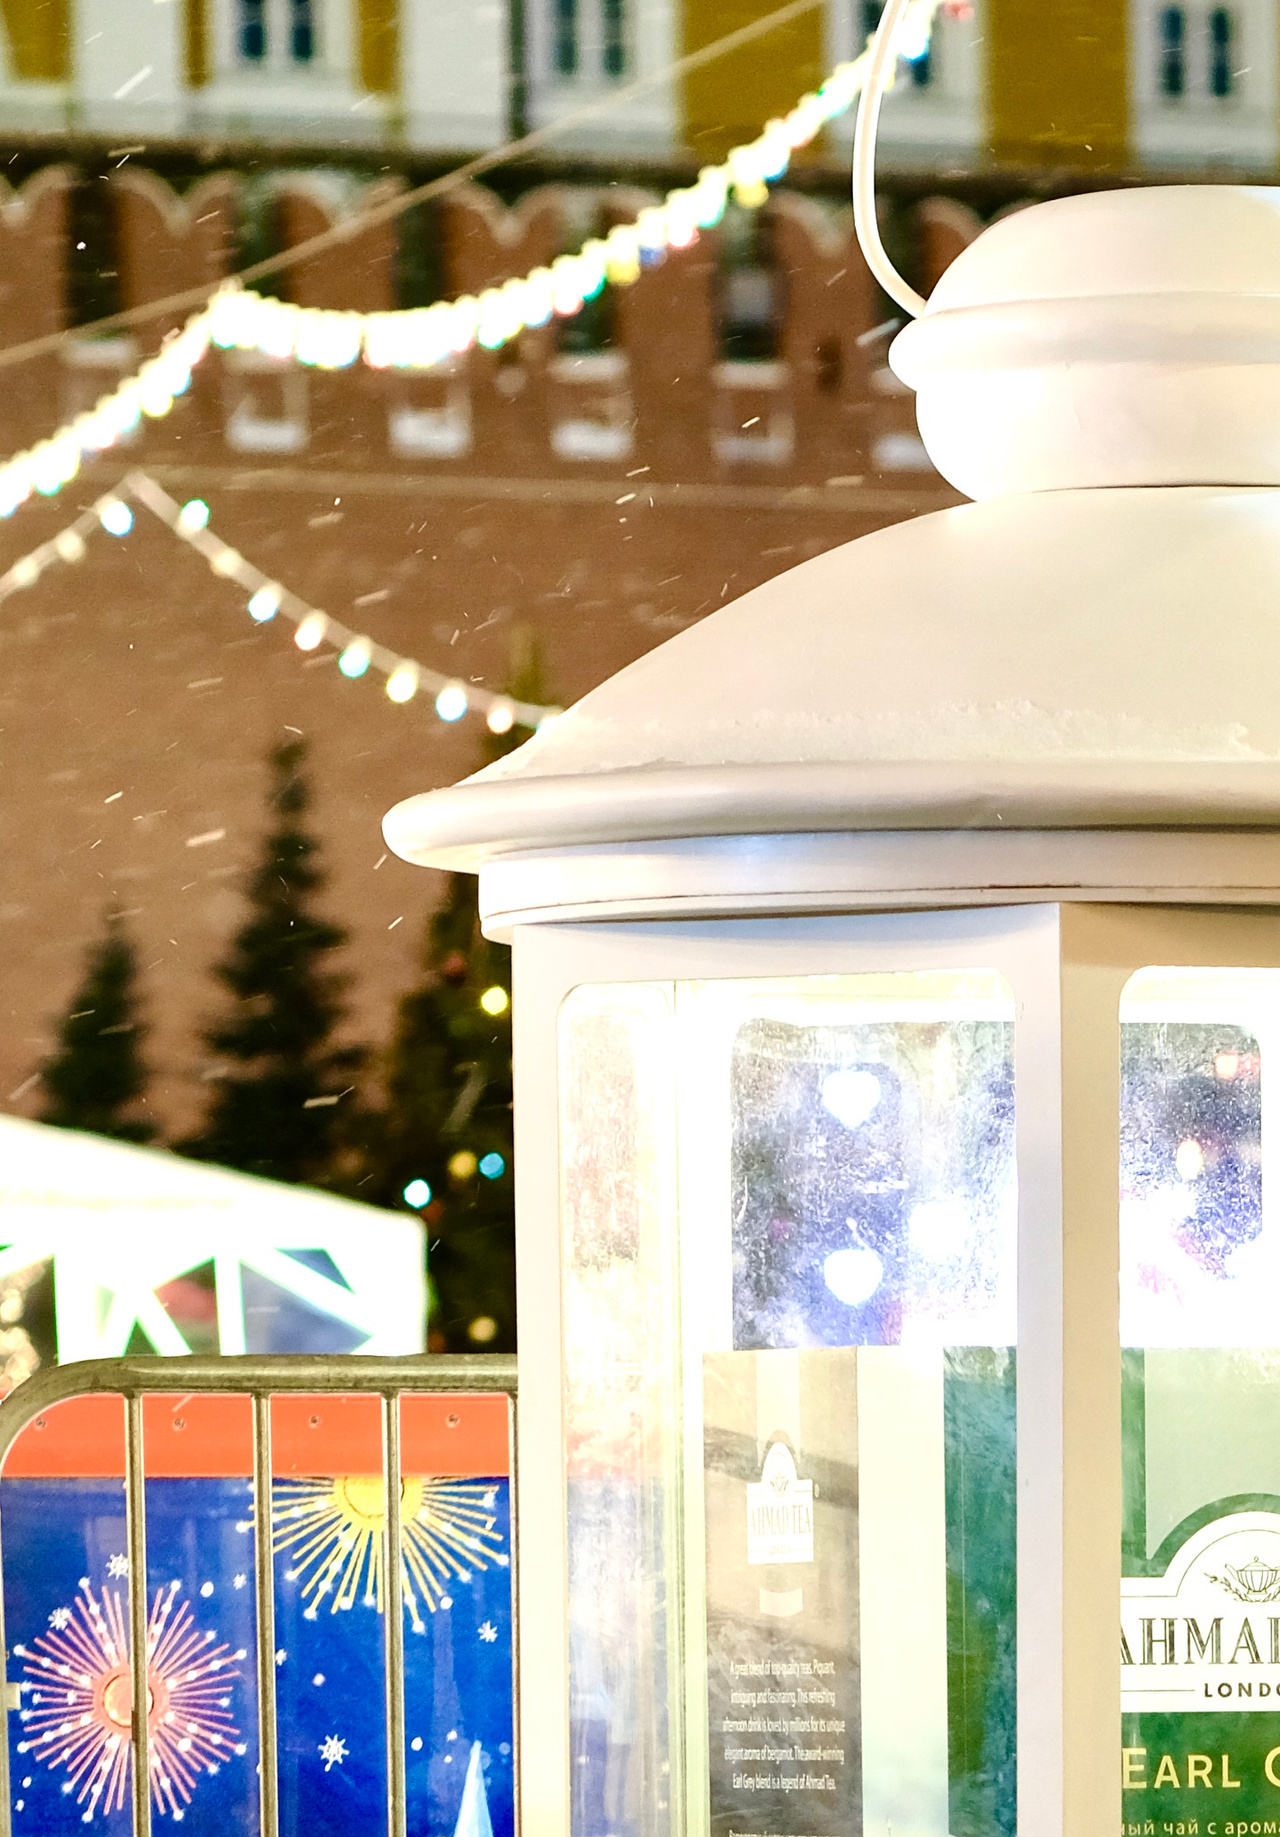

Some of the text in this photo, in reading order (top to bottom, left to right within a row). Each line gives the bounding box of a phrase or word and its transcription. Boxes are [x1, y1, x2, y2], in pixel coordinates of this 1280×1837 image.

[750, 1504, 811, 1536] AHMAD TEA
[1122, 1747, 1241, 1789] EARL
[1163, 1818, 1199, 1835] чай
[1207, 1822, 1217, 1835] с
